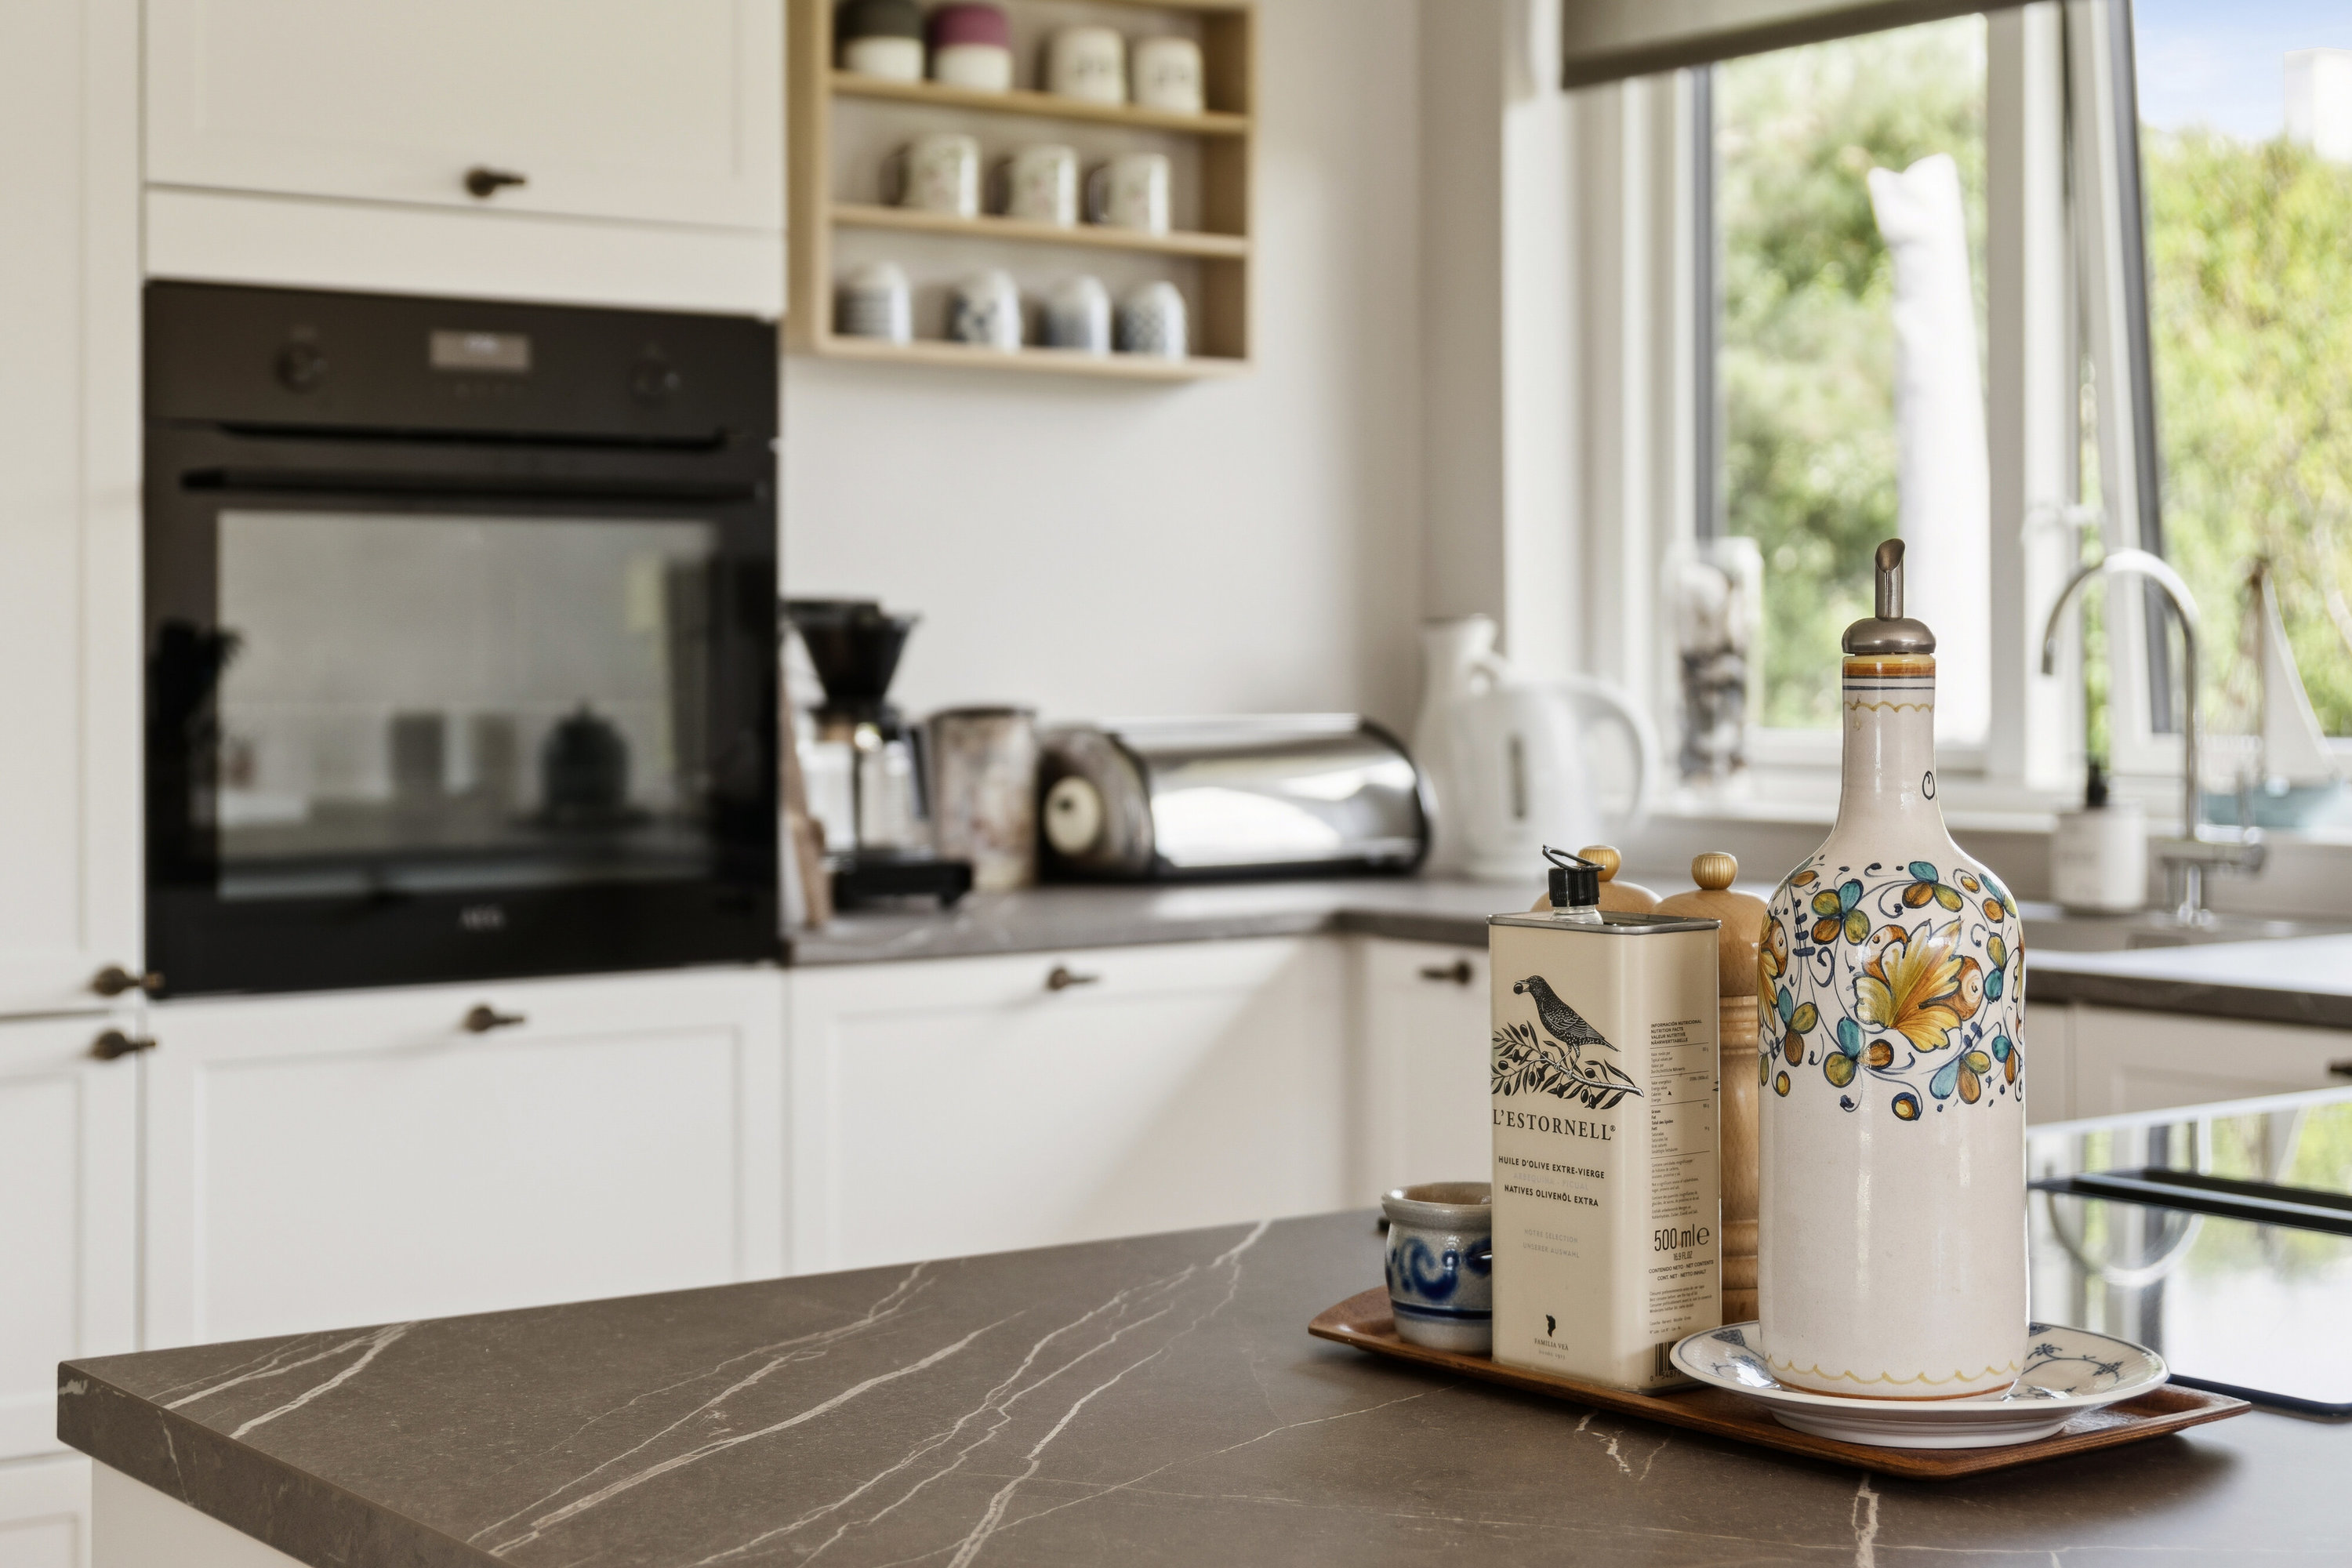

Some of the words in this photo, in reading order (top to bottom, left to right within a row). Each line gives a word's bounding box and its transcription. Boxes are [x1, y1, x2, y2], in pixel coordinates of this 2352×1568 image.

[1498, 1156, 1519, 1166] HUILE
[1522, 1159, 1550, 1171] D'OLIVE
[1552, 1163, 1605, 1179] EXTRE-VIERGE
[1504, 1184, 1534, 1196] NATIVES
[1573, 1196, 1599, 1207] EXTRA
[1654, 1228, 1677, 1251] 500
